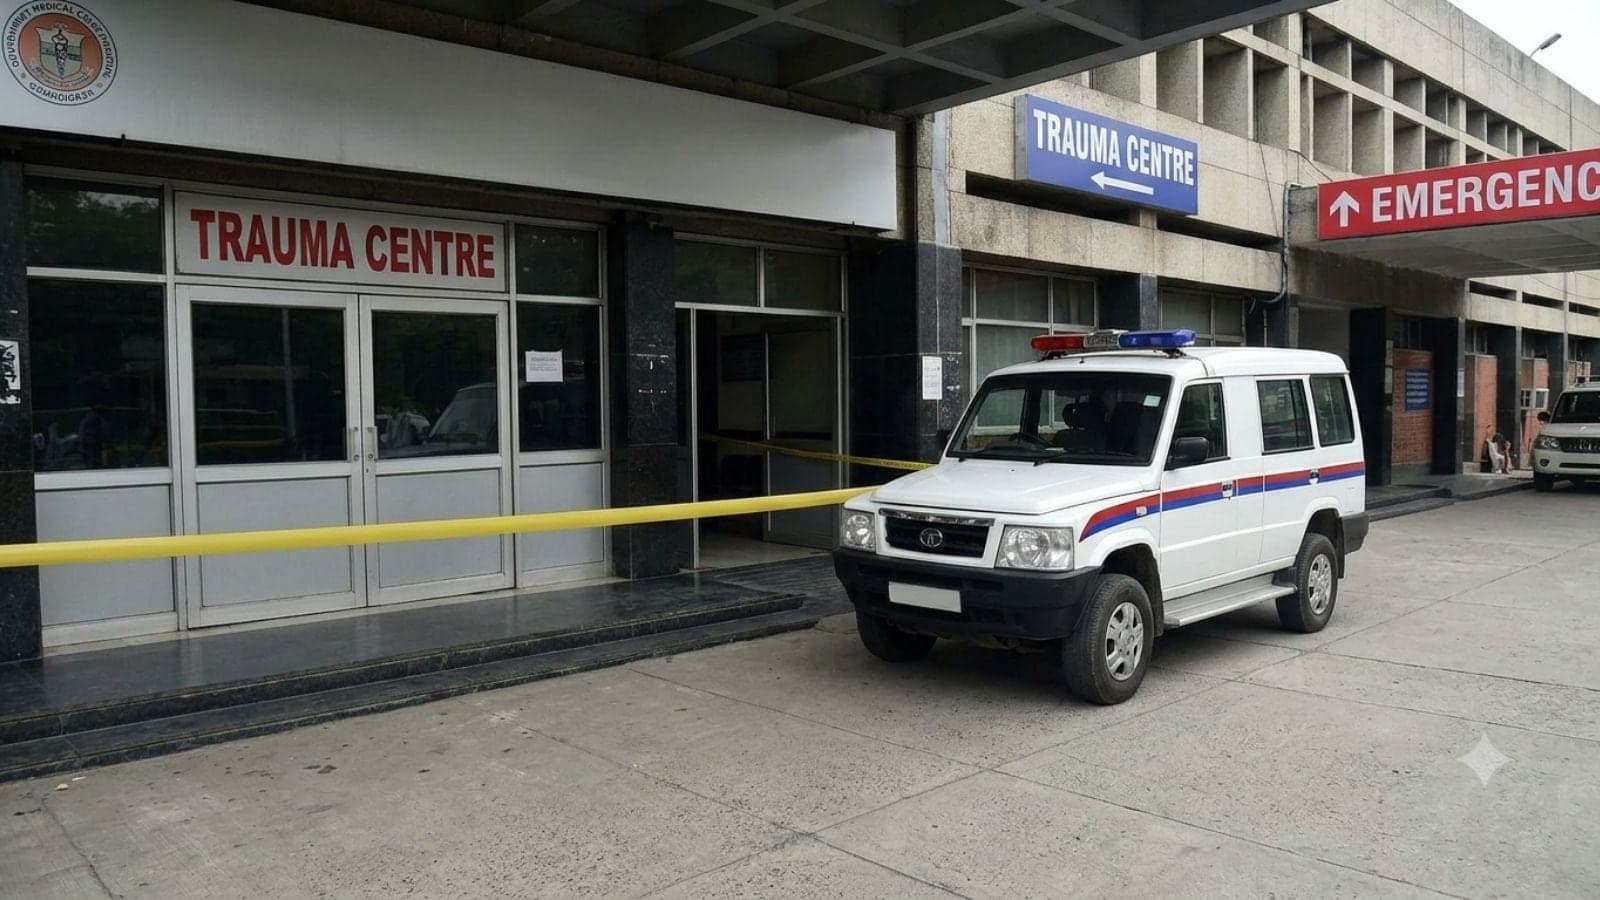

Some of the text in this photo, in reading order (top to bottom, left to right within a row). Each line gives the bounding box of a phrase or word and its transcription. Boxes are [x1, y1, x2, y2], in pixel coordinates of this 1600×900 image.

[1033, 107, 1195, 186] TRAUMA CENTRE
[1371, 160, 1600, 224] EMERGENC
[190, 209, 496, 279] TRAUMA CENTRE
